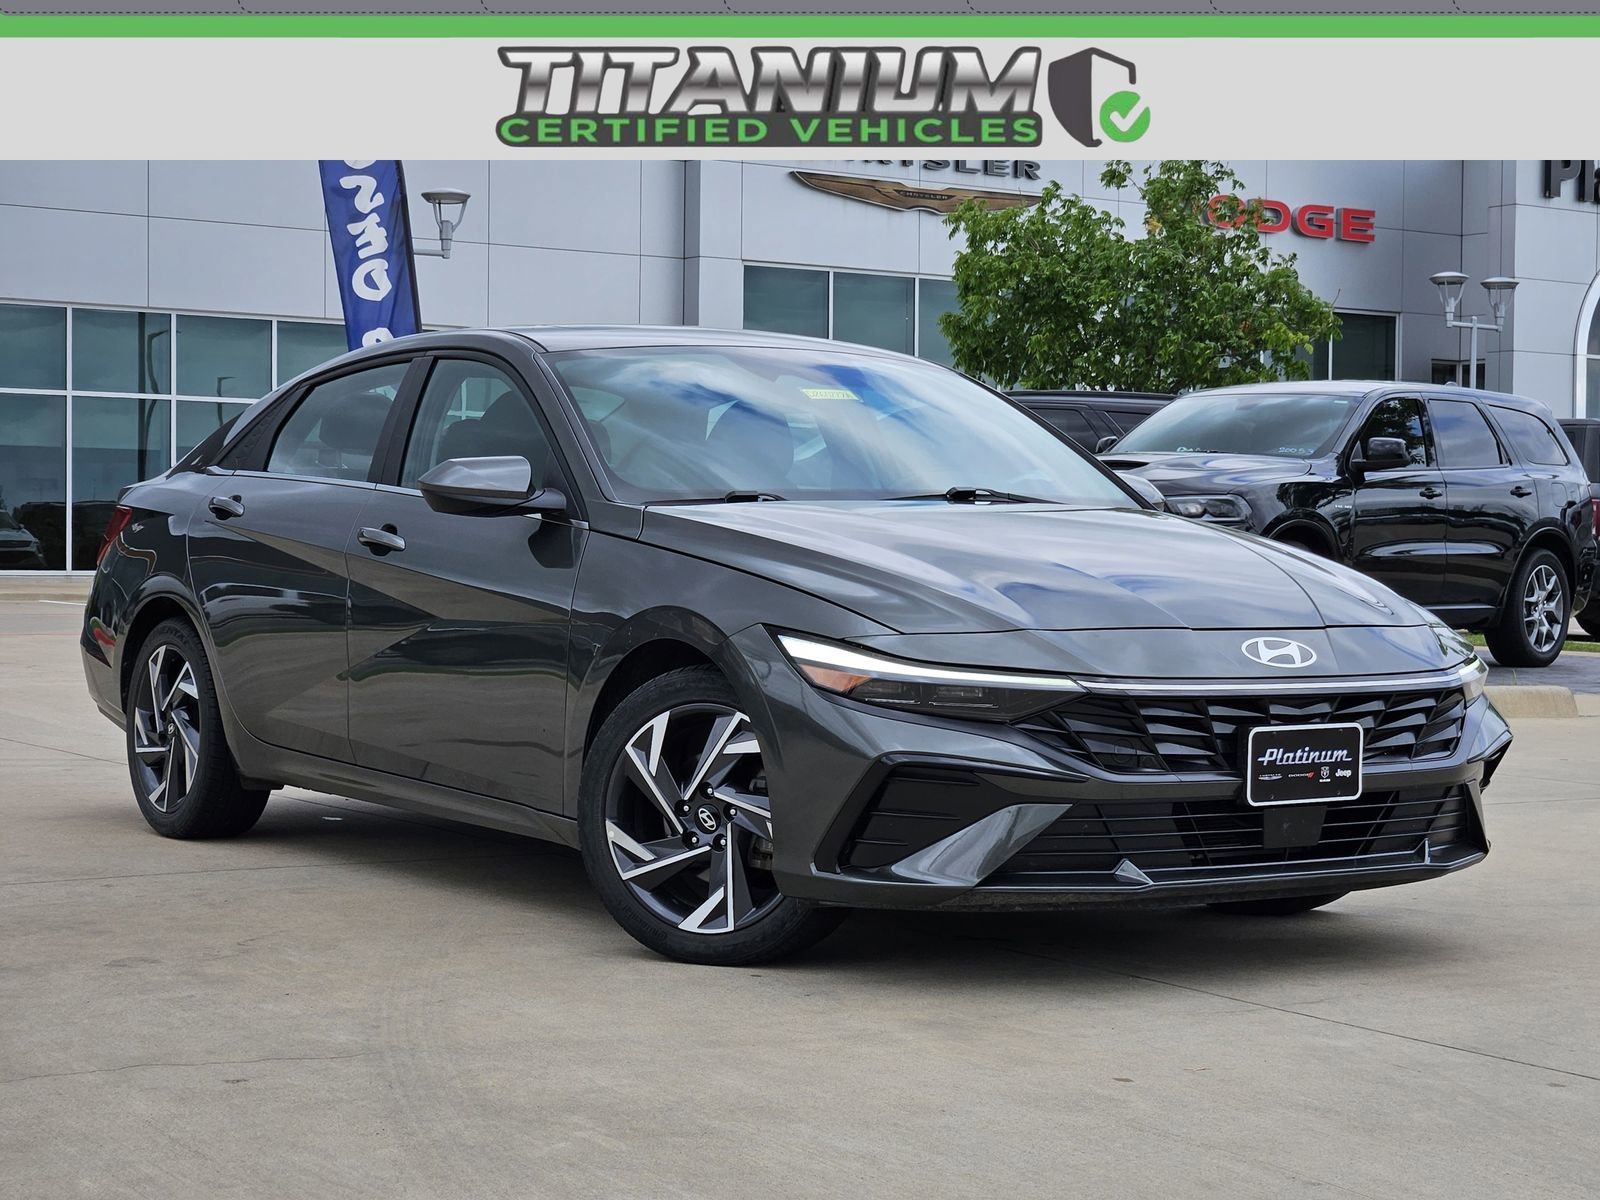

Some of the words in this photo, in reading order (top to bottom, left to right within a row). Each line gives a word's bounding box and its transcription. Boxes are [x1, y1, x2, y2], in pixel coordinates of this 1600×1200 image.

[1202, 194, 1376, 244] ODGE
[1257, 746, 1353, 766] Platinum
[1335, 768, 1352, 778] Jeep
